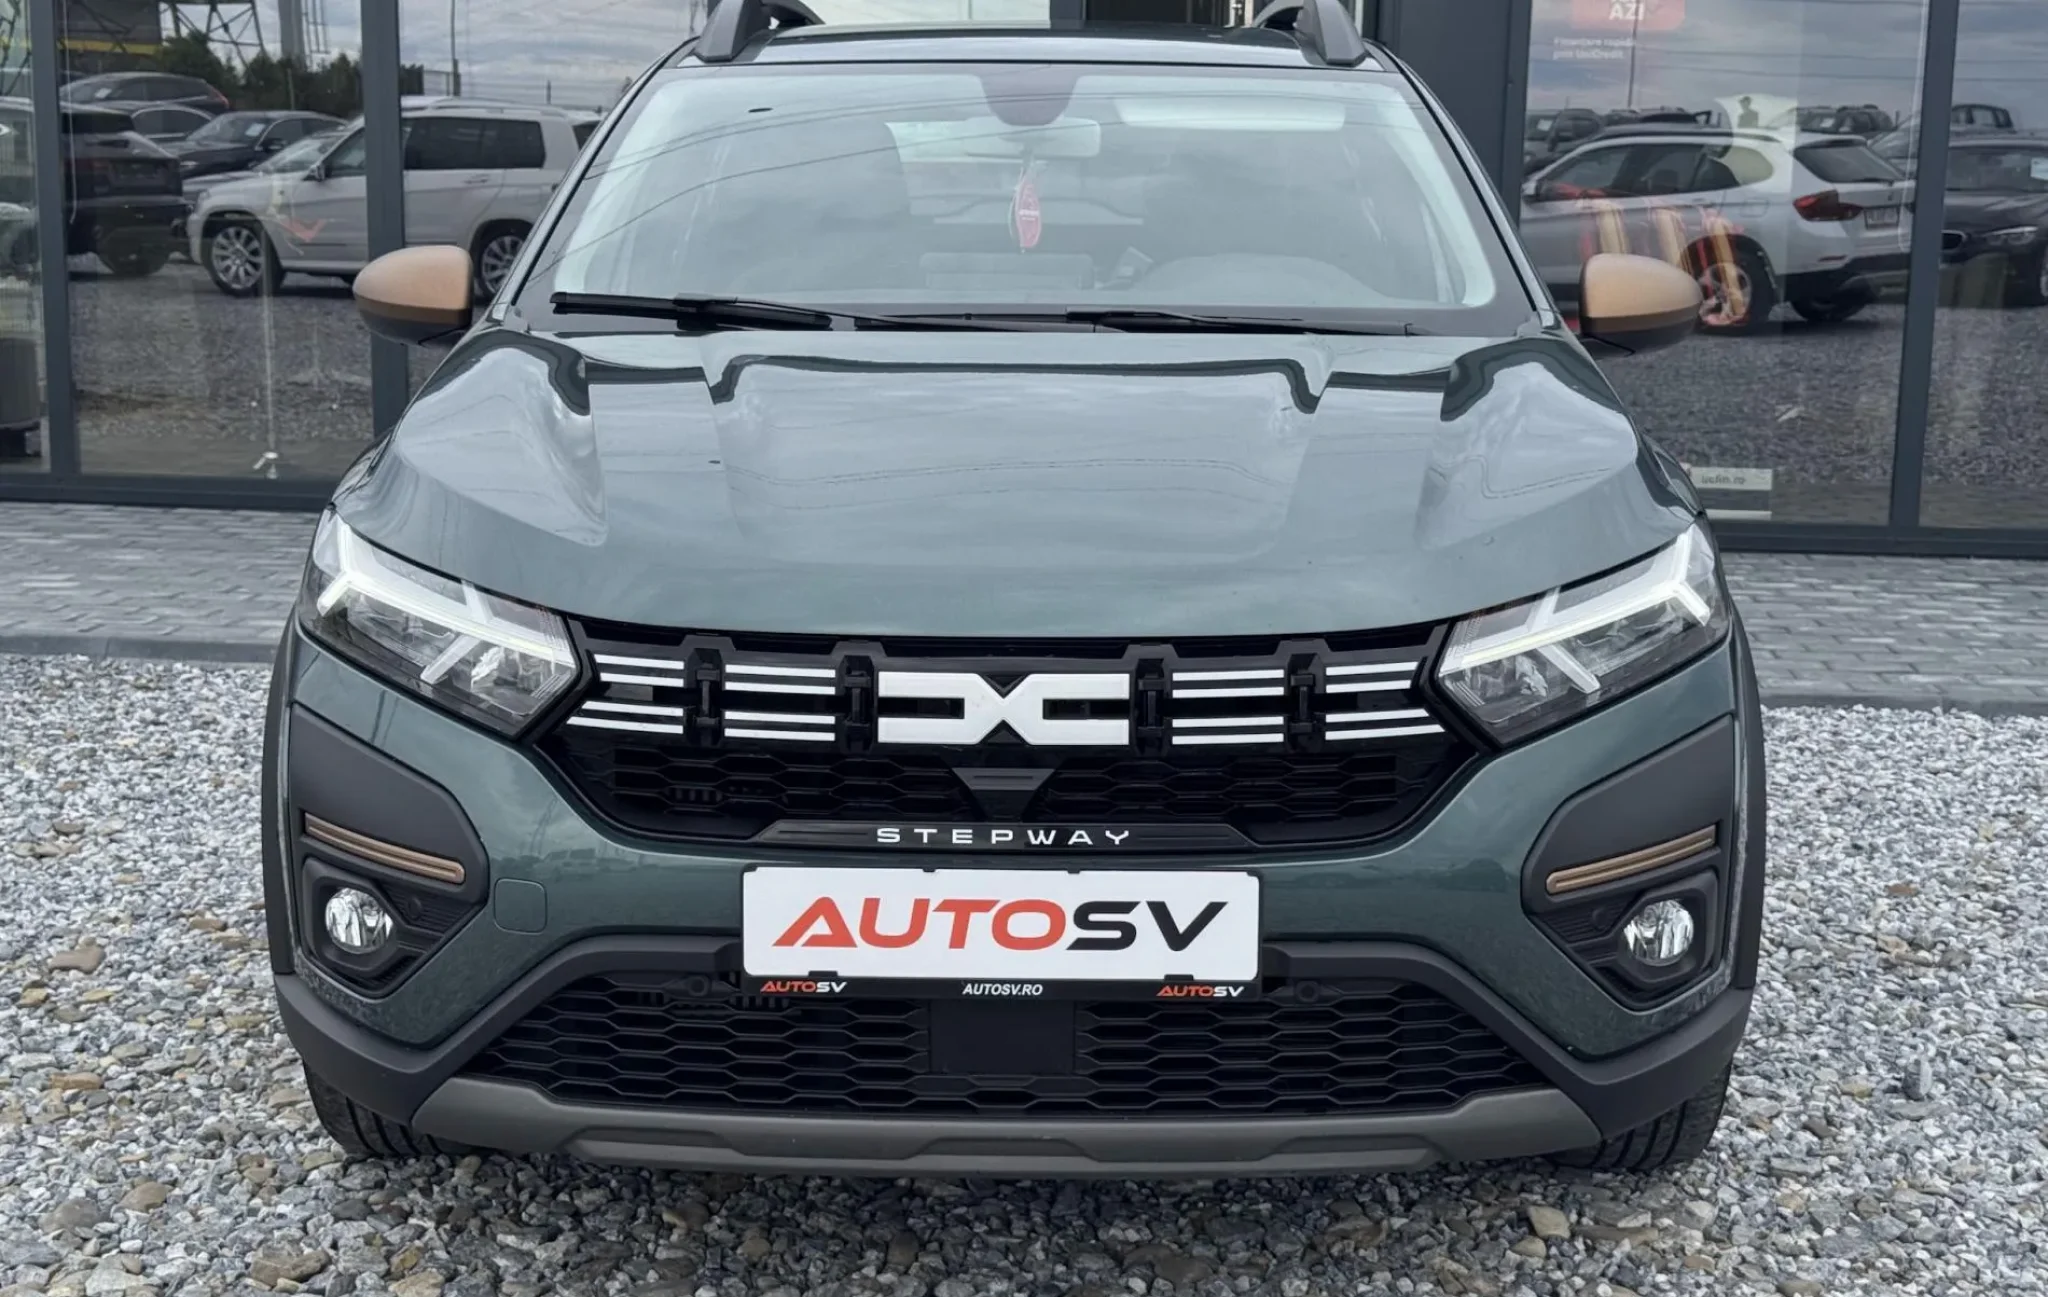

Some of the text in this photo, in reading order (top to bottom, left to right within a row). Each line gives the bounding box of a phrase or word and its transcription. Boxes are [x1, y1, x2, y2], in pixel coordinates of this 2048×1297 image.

[1608, 2, 1645, 20] AZI
[876, 827, 1129, 846] STEPWAY
[771, 895, 1229, 952] AUTOSV
[760, 980, 848, 994] AUTOSV
[962, 982, 1044, 996] AUTOSV.RO
[1156, 985, 1245, 998] AUTOSV
